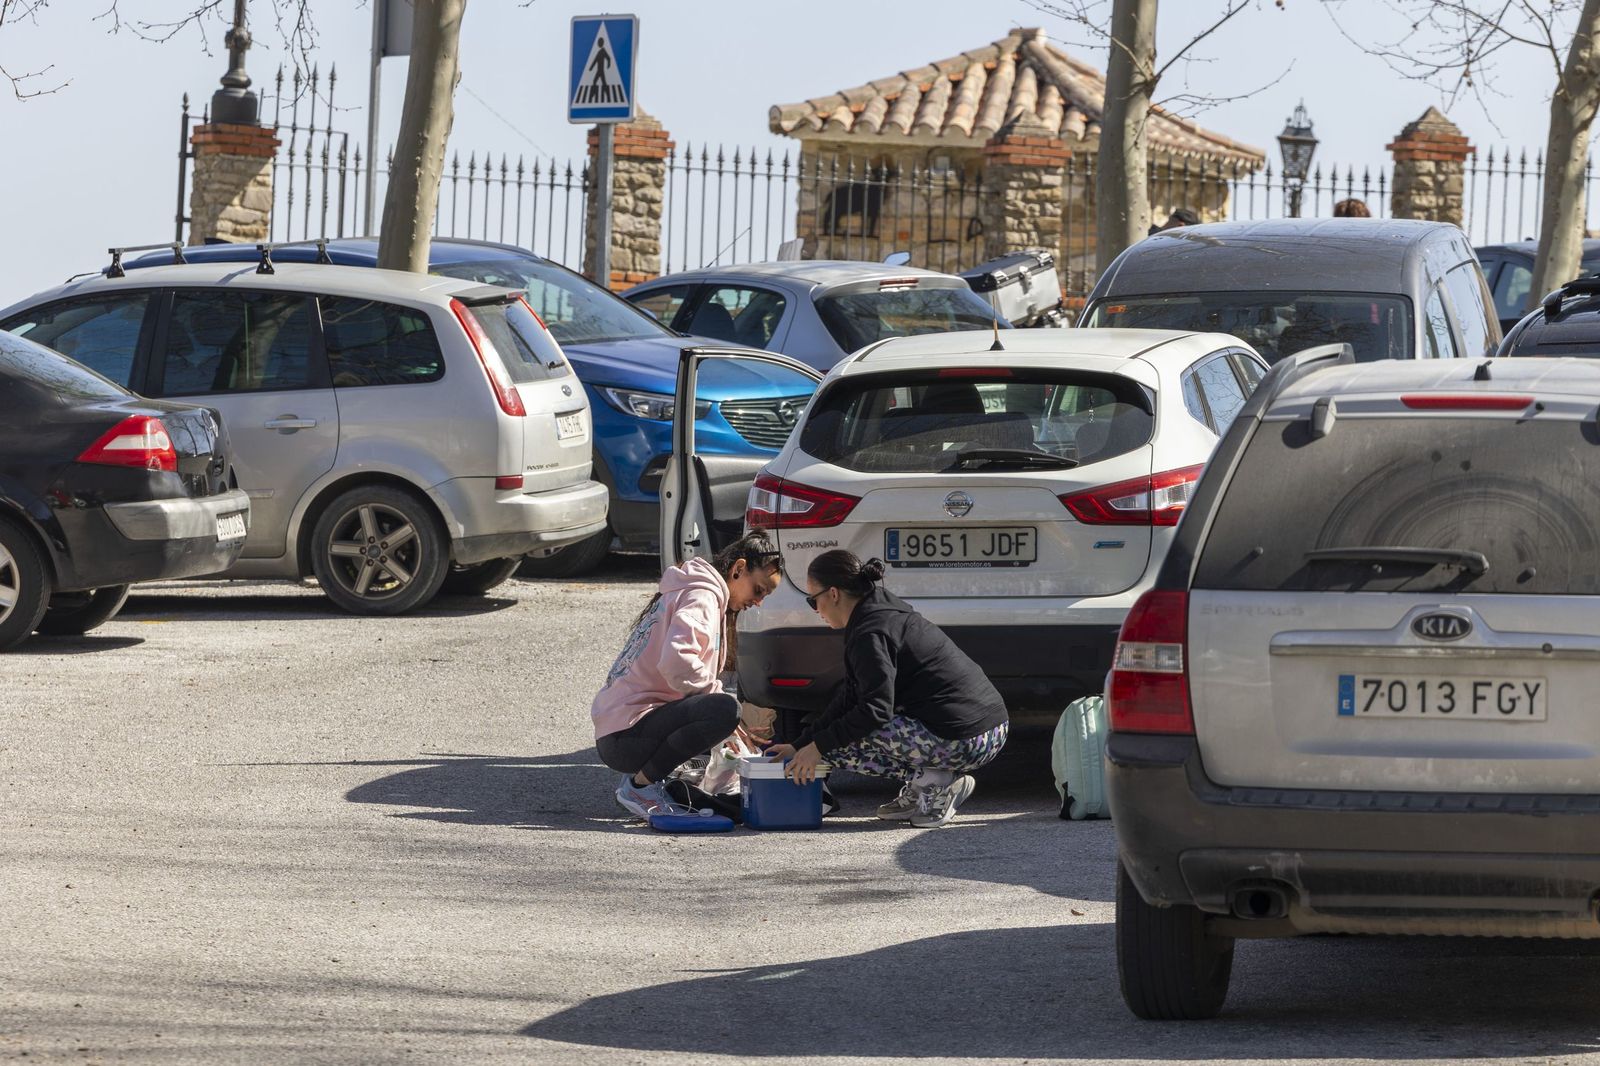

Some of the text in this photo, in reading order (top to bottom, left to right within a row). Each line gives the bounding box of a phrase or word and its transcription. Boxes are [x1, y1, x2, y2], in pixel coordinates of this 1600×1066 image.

[906, 533, 968, 557] 9651
[981, 532, 1029, 557] JDF
[928, 561, 992, 569] www.loretomotor.es
[1421, 617, 1462, 635] KIA
[1342, 679, 1541, 715] E 7013 FGY
